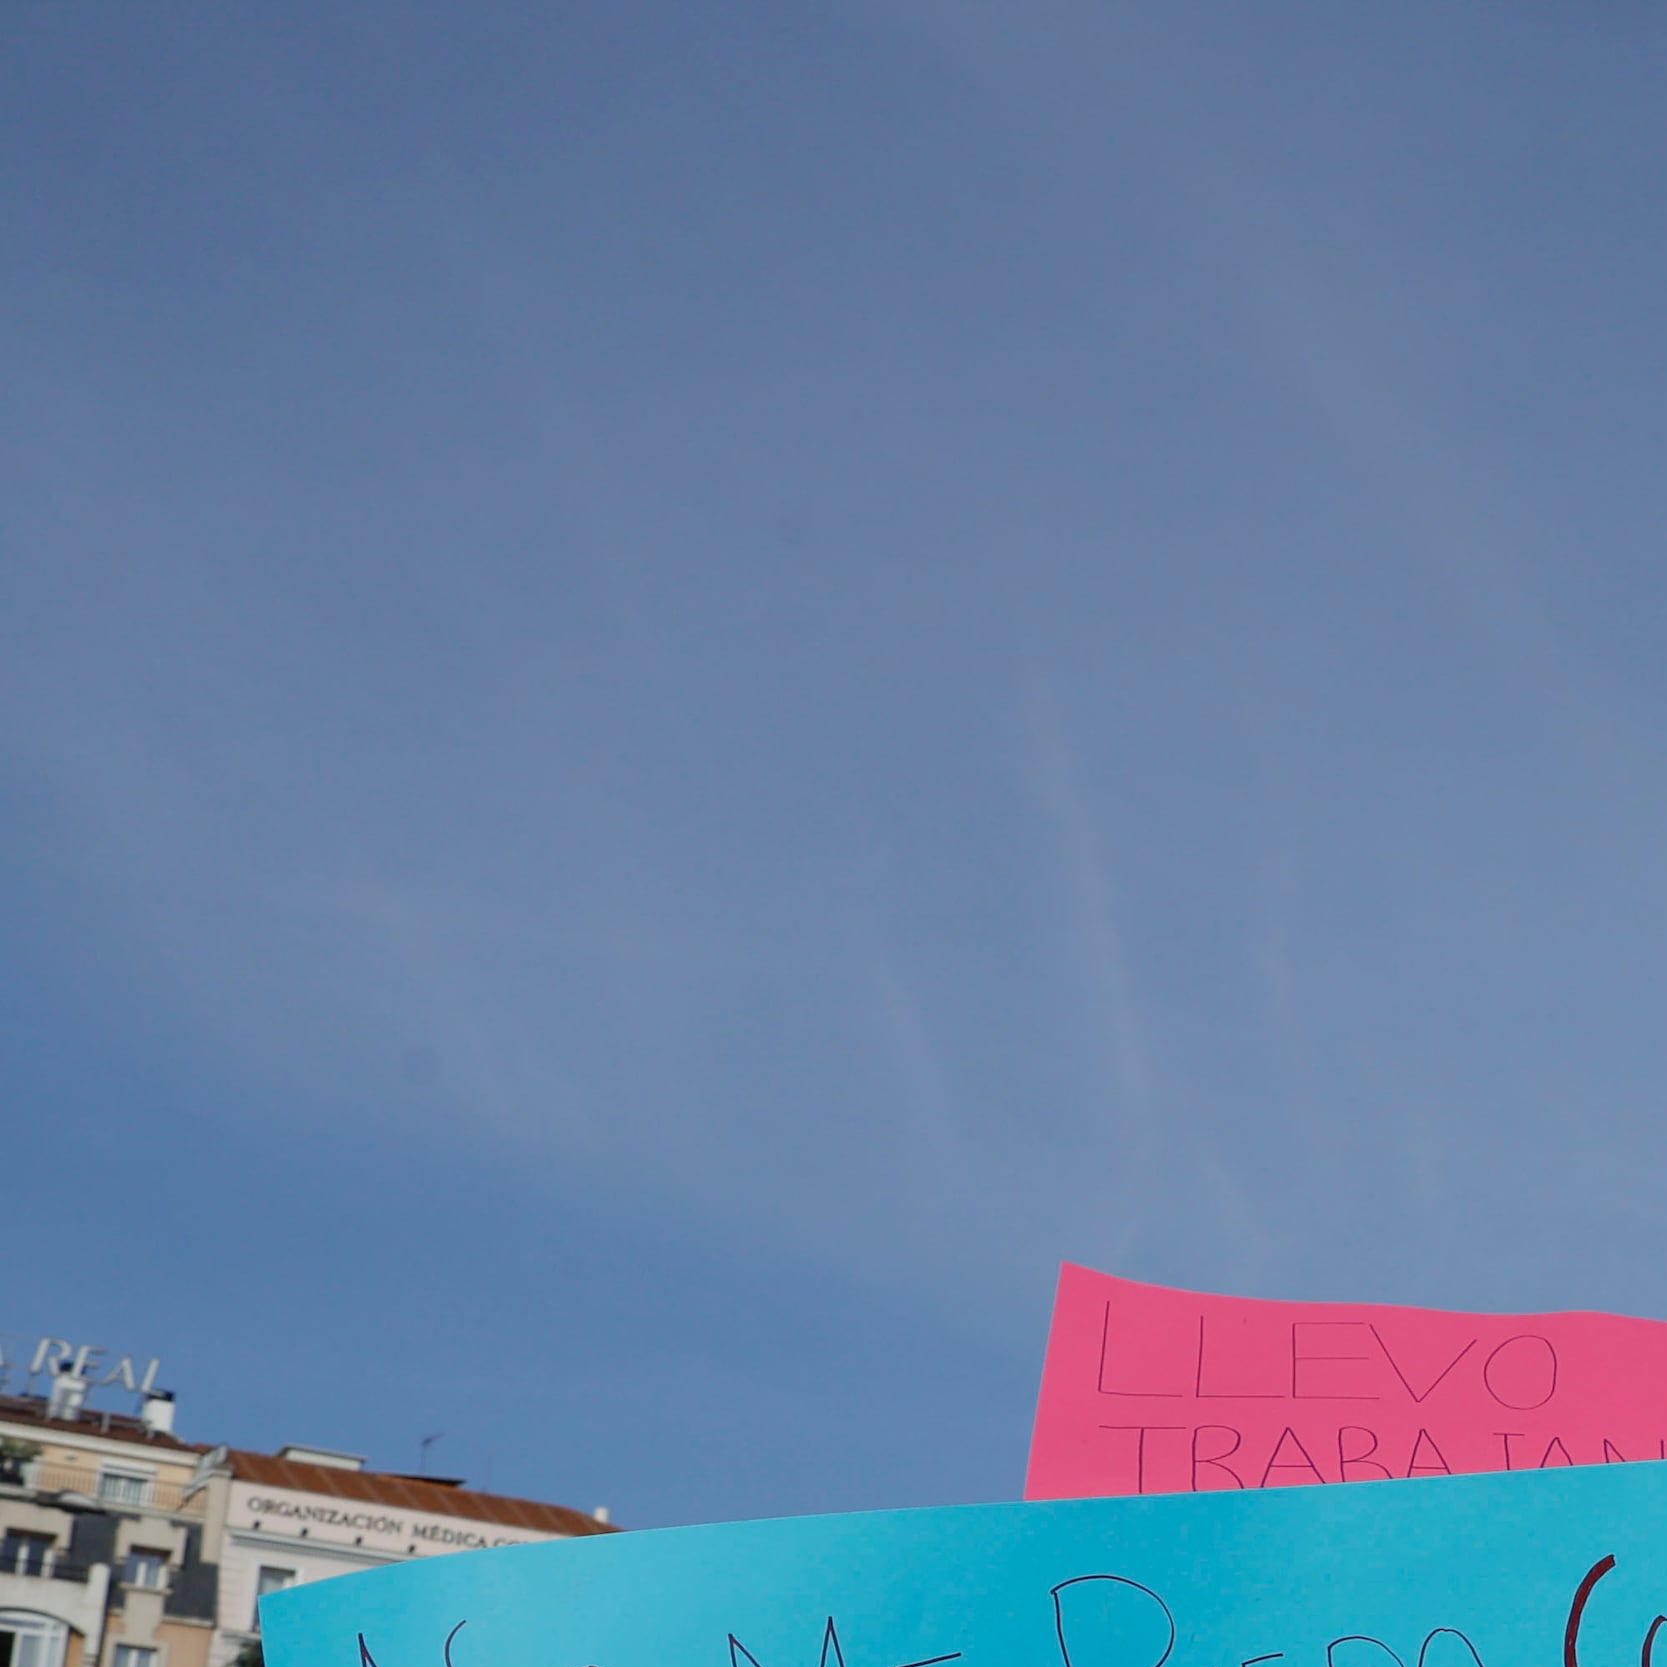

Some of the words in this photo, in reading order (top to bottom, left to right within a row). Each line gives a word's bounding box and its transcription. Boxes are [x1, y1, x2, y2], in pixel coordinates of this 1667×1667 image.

[29, 1336, 162, 1393] REAL
[1097, 1300, 1558, 1411] LLEVO
[246, 1496, 402, 1534] ORGANIZACIÓN
[411, 1522, 487, 1548] MÉDICA
